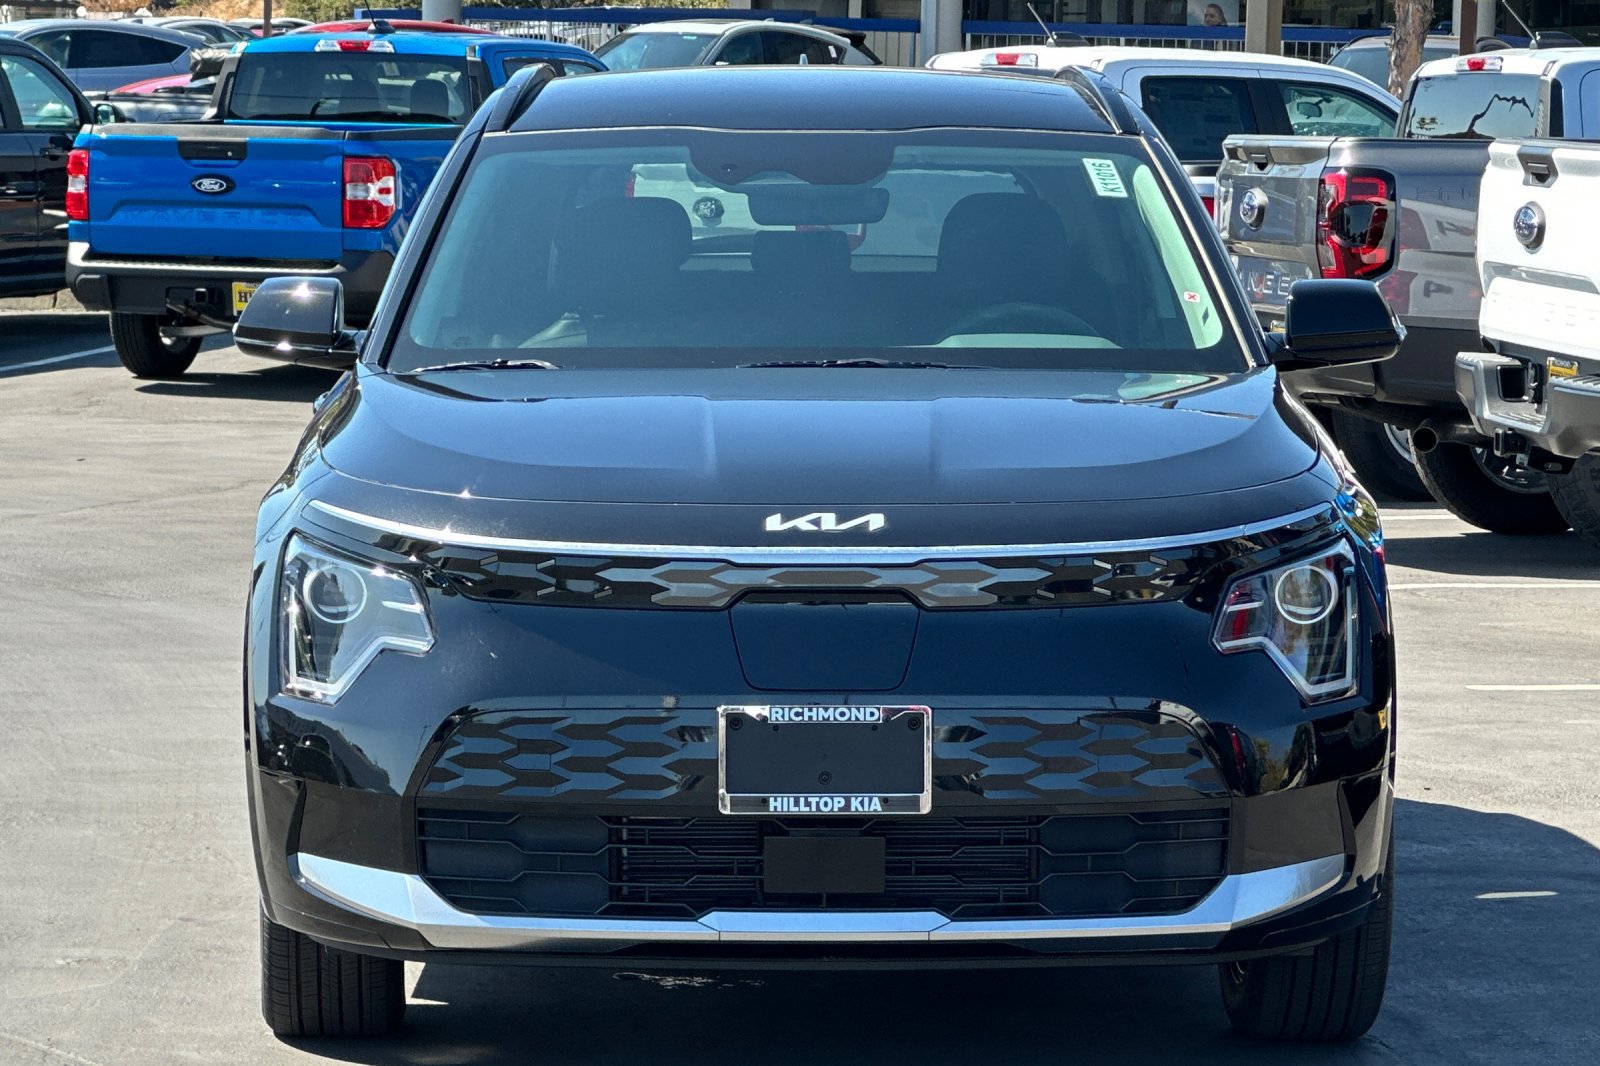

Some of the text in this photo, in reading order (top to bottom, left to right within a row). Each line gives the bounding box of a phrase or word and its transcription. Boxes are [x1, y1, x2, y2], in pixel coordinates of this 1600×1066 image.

[1091, 163, 1124, 193] K11016
[770, 706, 880, 722] RICHMOND
[769, 796, 883, 812] HILLTOP KIA
